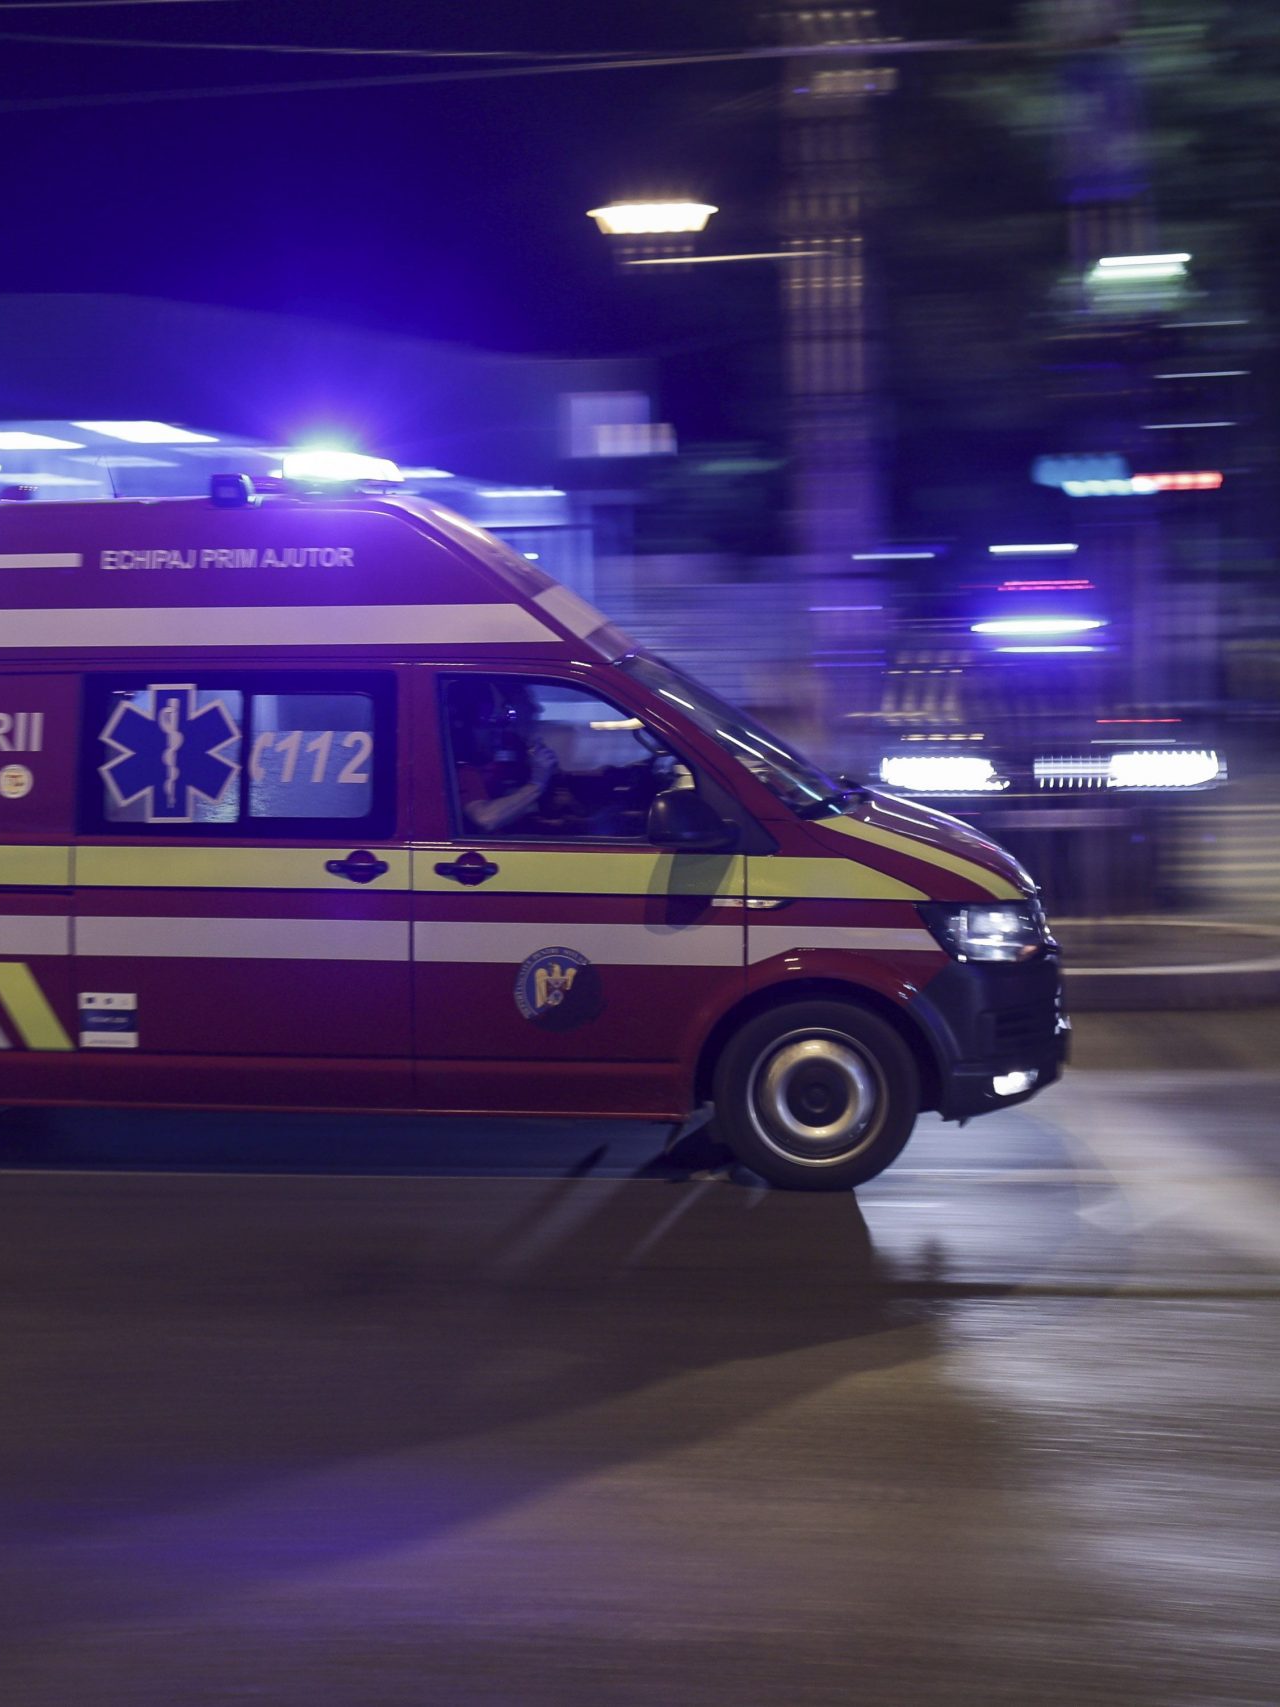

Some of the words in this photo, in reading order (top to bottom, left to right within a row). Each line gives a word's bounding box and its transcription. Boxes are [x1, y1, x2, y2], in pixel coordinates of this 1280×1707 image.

[100, 549, 197, 569] ECHIPAJ
[200, 549, 257, 568] PRIM
[259, 547, 355, 568] AJUTOR
[275, 730, 374, 784] 112
